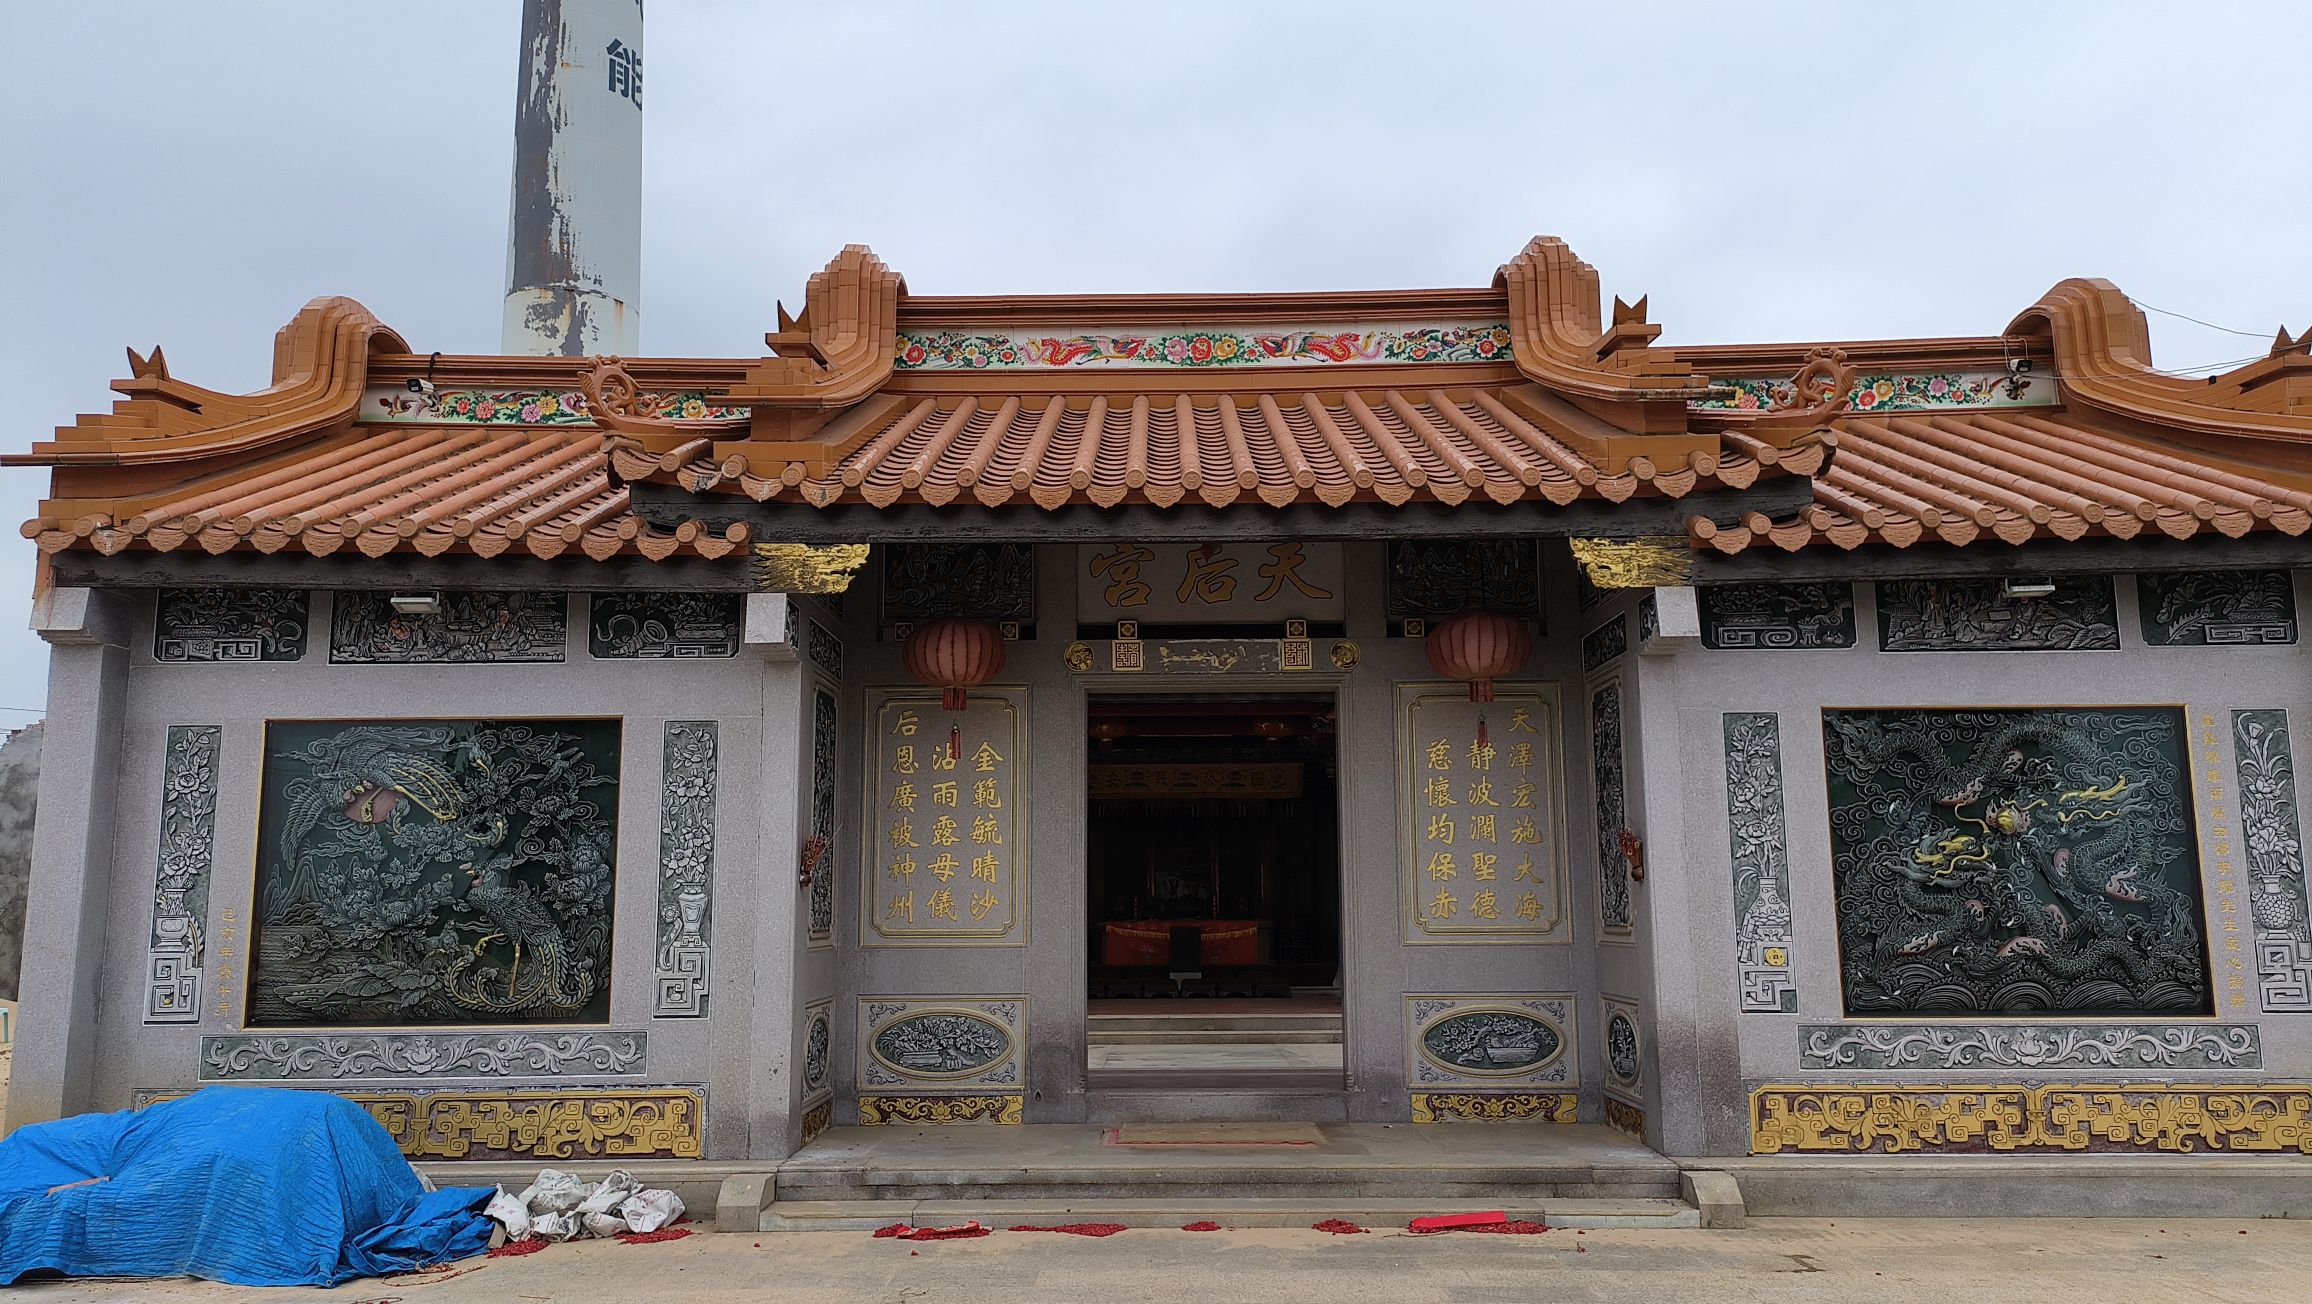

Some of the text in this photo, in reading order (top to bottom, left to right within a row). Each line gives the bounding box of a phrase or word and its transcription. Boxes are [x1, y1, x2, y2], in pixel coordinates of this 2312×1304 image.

[1089, 543, 1333, 607] 天后宮
[926, 742, 961, 922] 沾雨露母儀
[1424, 738, 1458, 919] 慈懷均保赤
[1508, 706, 1543, 921] 天澤宏施大海
